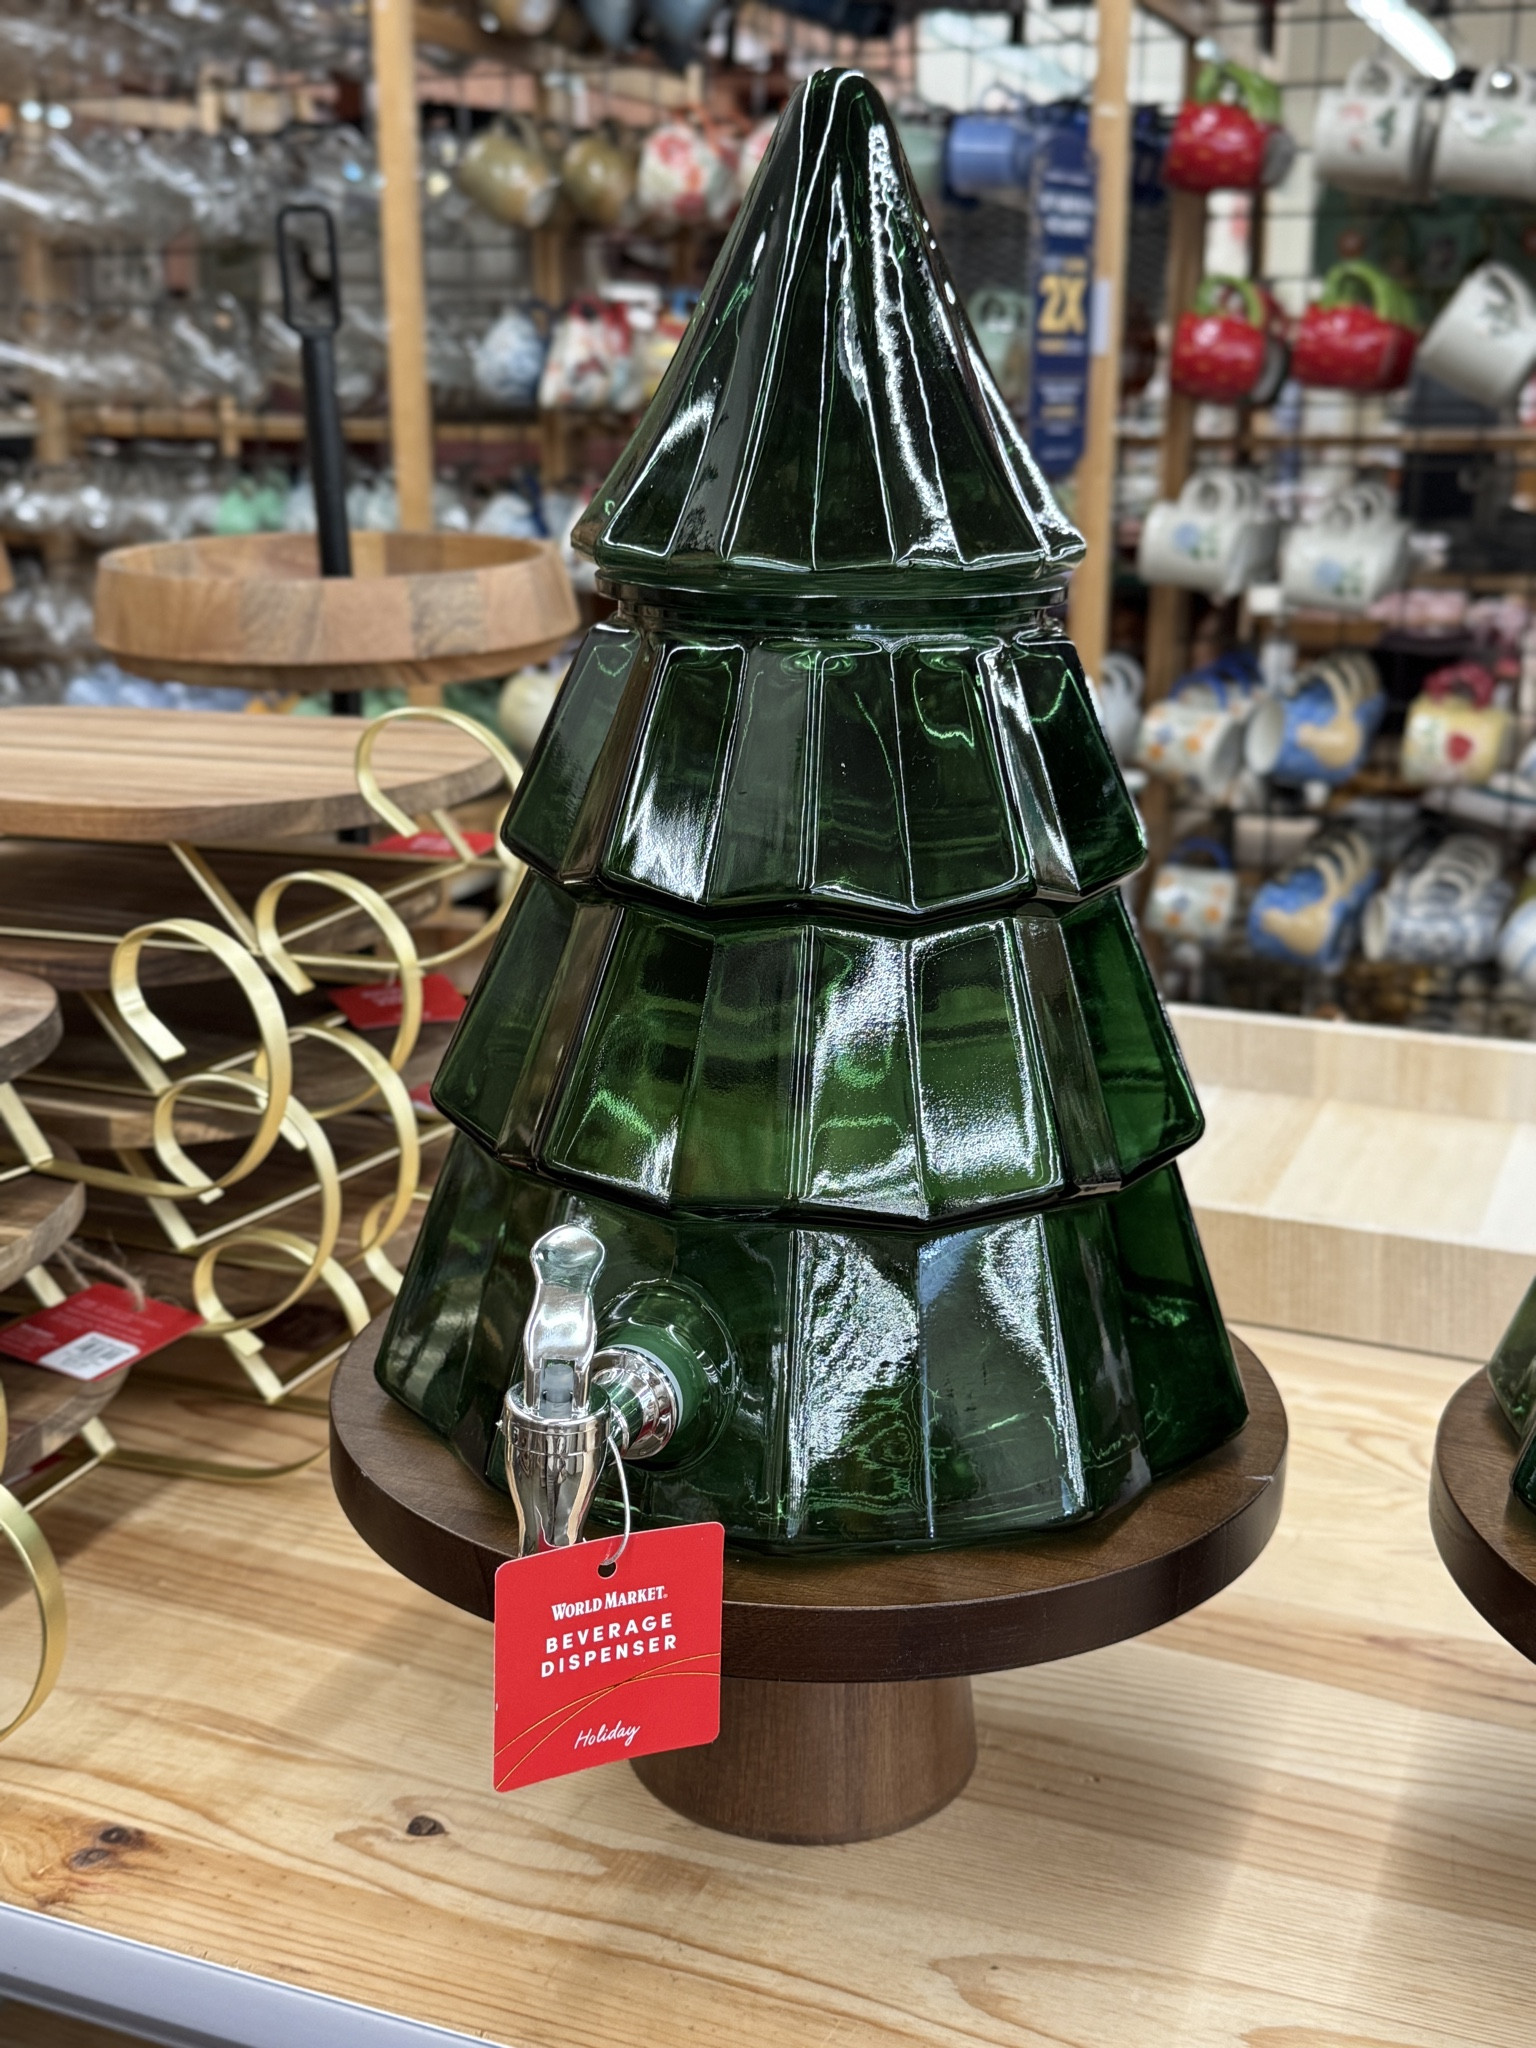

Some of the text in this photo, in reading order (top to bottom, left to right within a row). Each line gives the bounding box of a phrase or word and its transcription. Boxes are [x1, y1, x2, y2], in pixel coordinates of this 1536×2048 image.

[1038, 274, 1087, 335] 2X
[551, 1602, 602, 1621] WORLD
[546, 1612, 672, 1654] BEVERAGE
[541, 1634, 677, 1678] DISPENSER
[574, 1720, 640, 1749] Holiday
